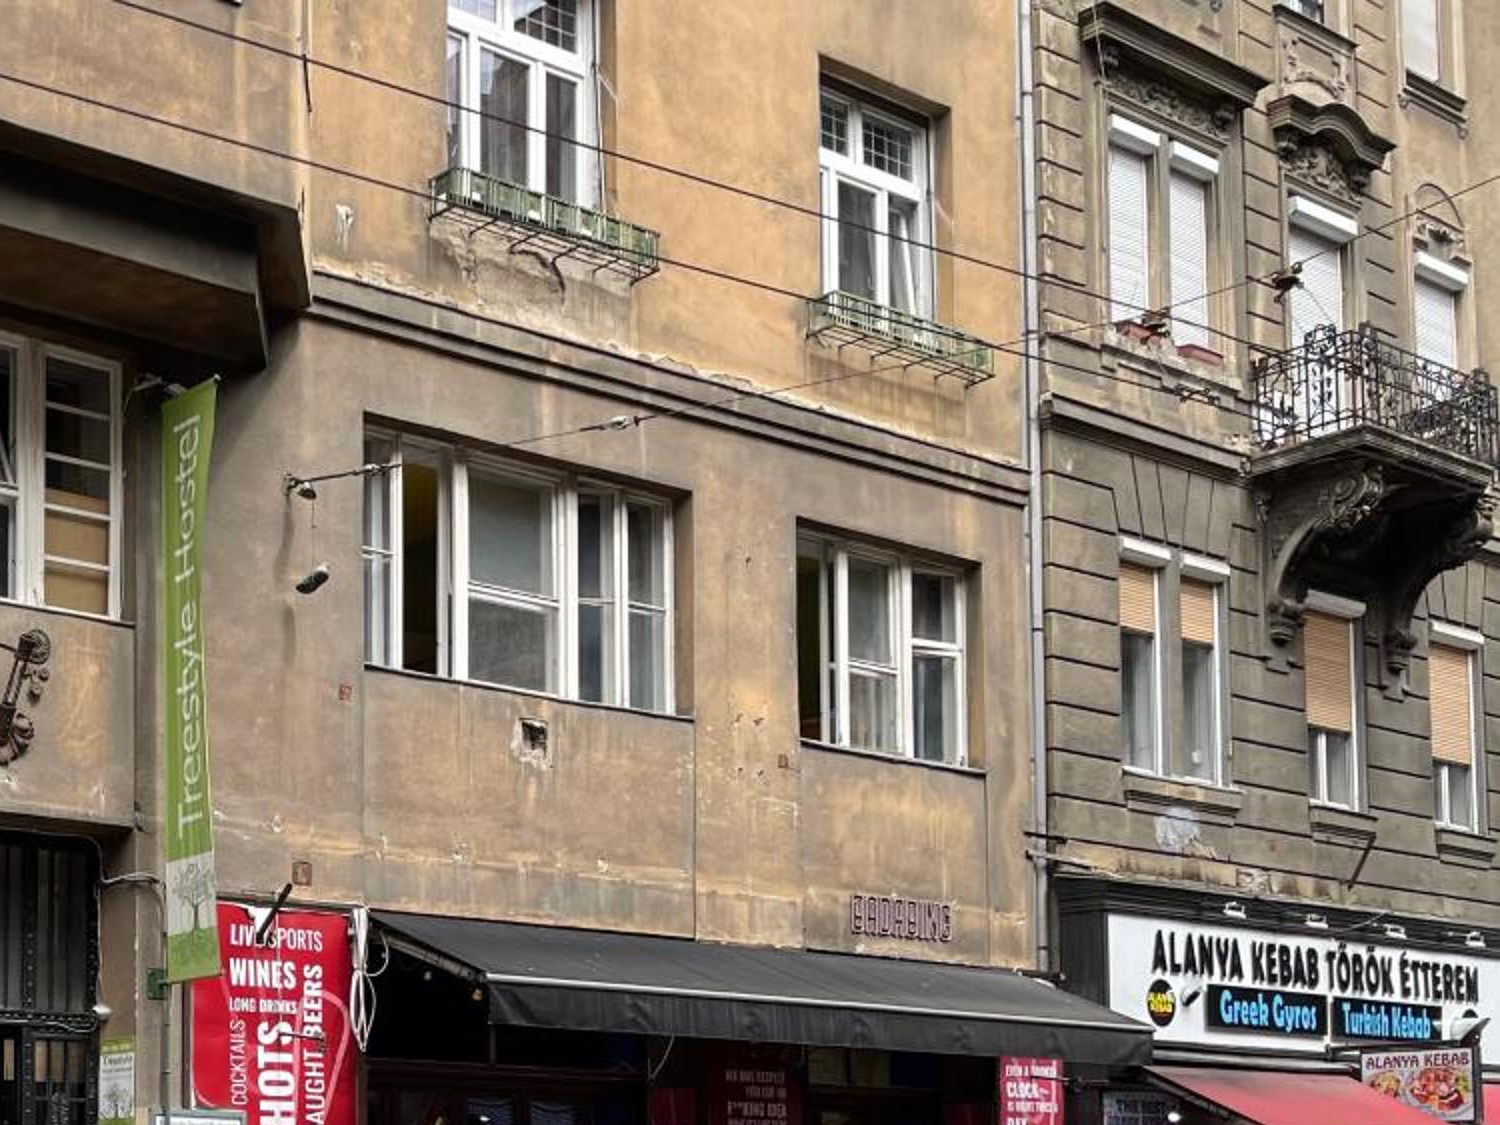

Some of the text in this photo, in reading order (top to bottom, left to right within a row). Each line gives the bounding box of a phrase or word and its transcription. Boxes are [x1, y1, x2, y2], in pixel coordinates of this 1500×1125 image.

[173, 415, 204, 838] Treestyle Hostel
[851, 894, 955, 943] BADABING
[230, 958, 296, 989] WINES
[1151, 930, 1480, 1004] ALANYA KEBAB TÖRÖK ÉTTEREM
[229, 998, 256, 1013] LONG
[303, 964, 323, 1040] BEERS
[1220, 990, 1318, 1033] Greek Gyros
[1342, 1002, 1432, 1040] Turkish Kebab
[231, 1019, 247, 1105] COCKTAILS
[1365, 1052, 1470, 1069] ALANYA KEBAB
[1006, 1081, 1039, 1098] CLOCK
